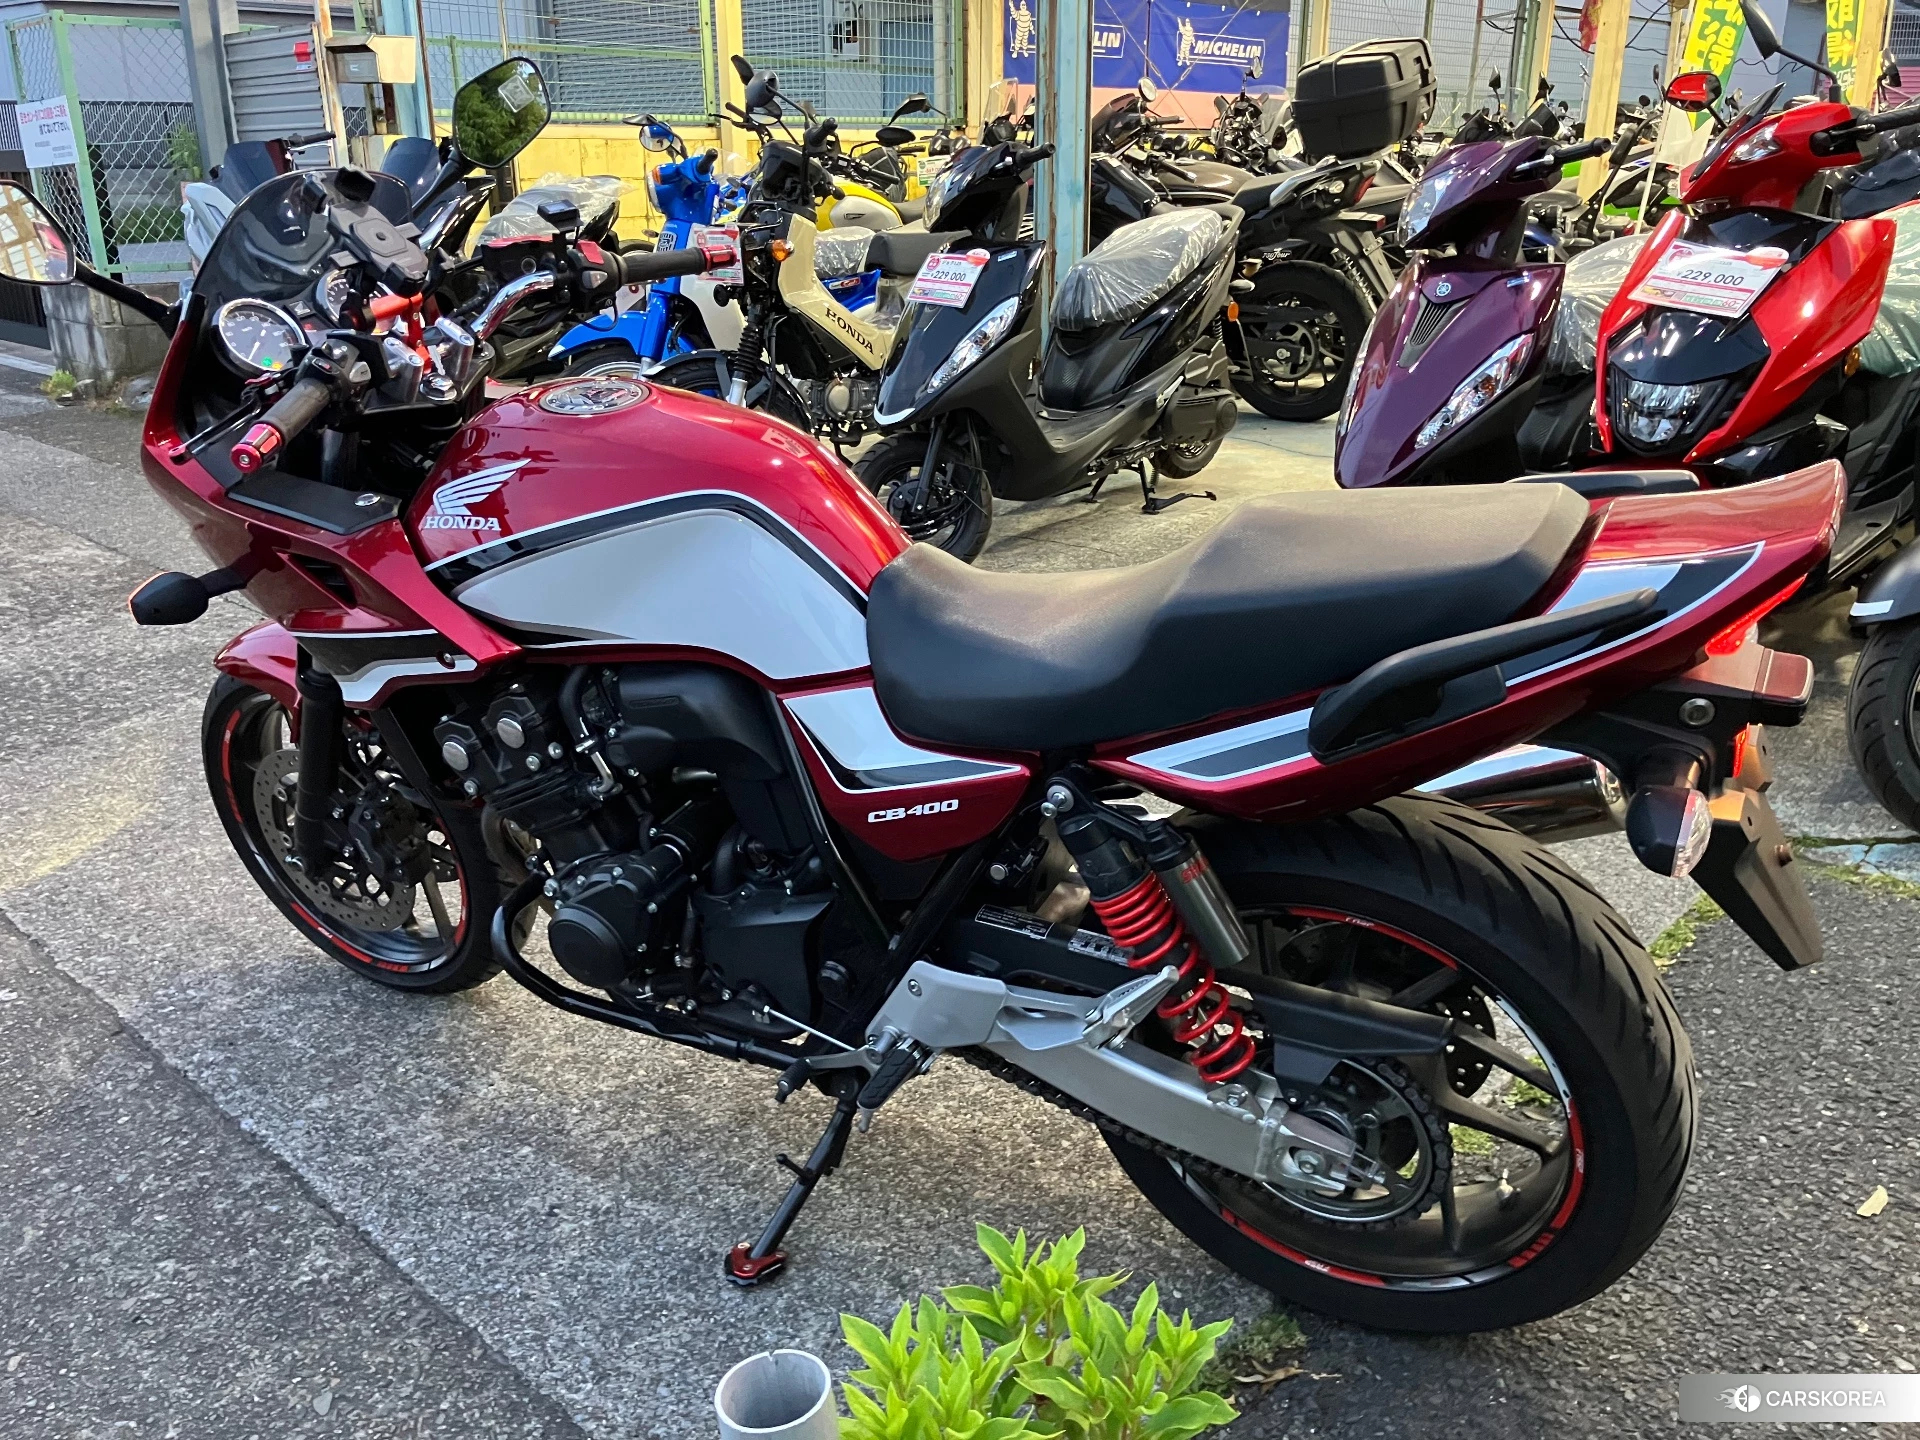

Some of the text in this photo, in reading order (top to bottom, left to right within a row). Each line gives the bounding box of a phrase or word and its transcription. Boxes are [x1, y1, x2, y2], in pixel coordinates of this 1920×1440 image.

[1194, 40, 1262, 59] MICHELIN
[825, 307, 875, 355] HONDA
[423, 516, 502, 531] HONDA
[867, 799, 959, 823] CB400
